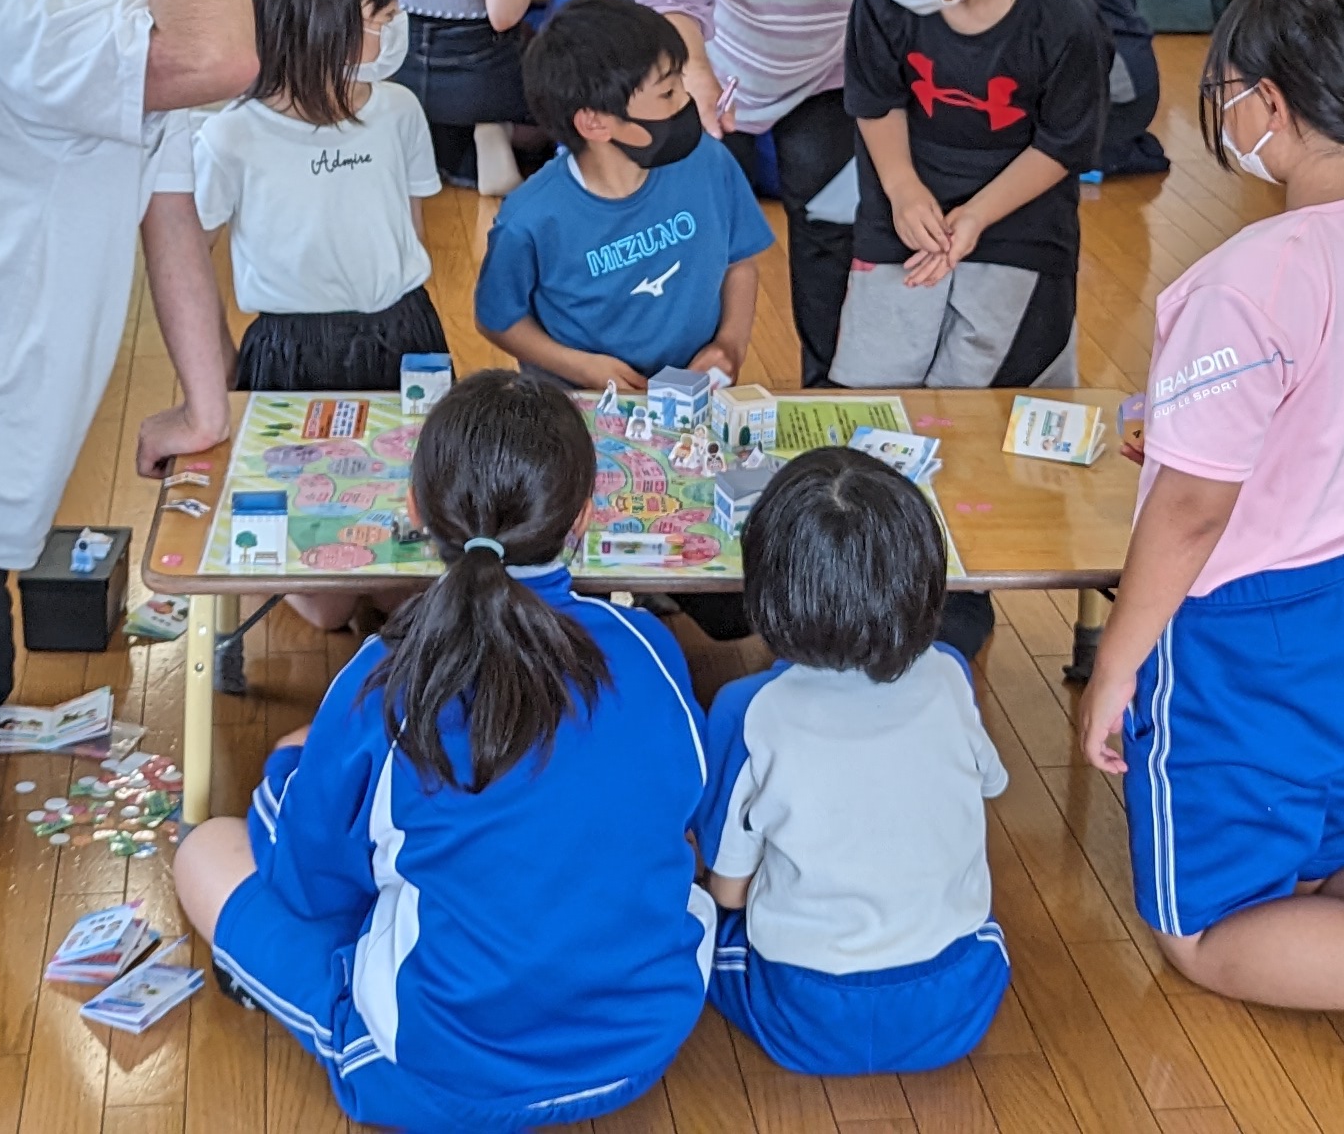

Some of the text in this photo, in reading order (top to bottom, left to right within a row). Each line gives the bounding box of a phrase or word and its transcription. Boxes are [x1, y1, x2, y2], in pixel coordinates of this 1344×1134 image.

[311, 149, 373, 176] Admire
[586, 210, 697, 278] MIZUNO
[1153, 347, 1239, 398] IRAUDM
[1192, 379, 1238, 401] SPORT
